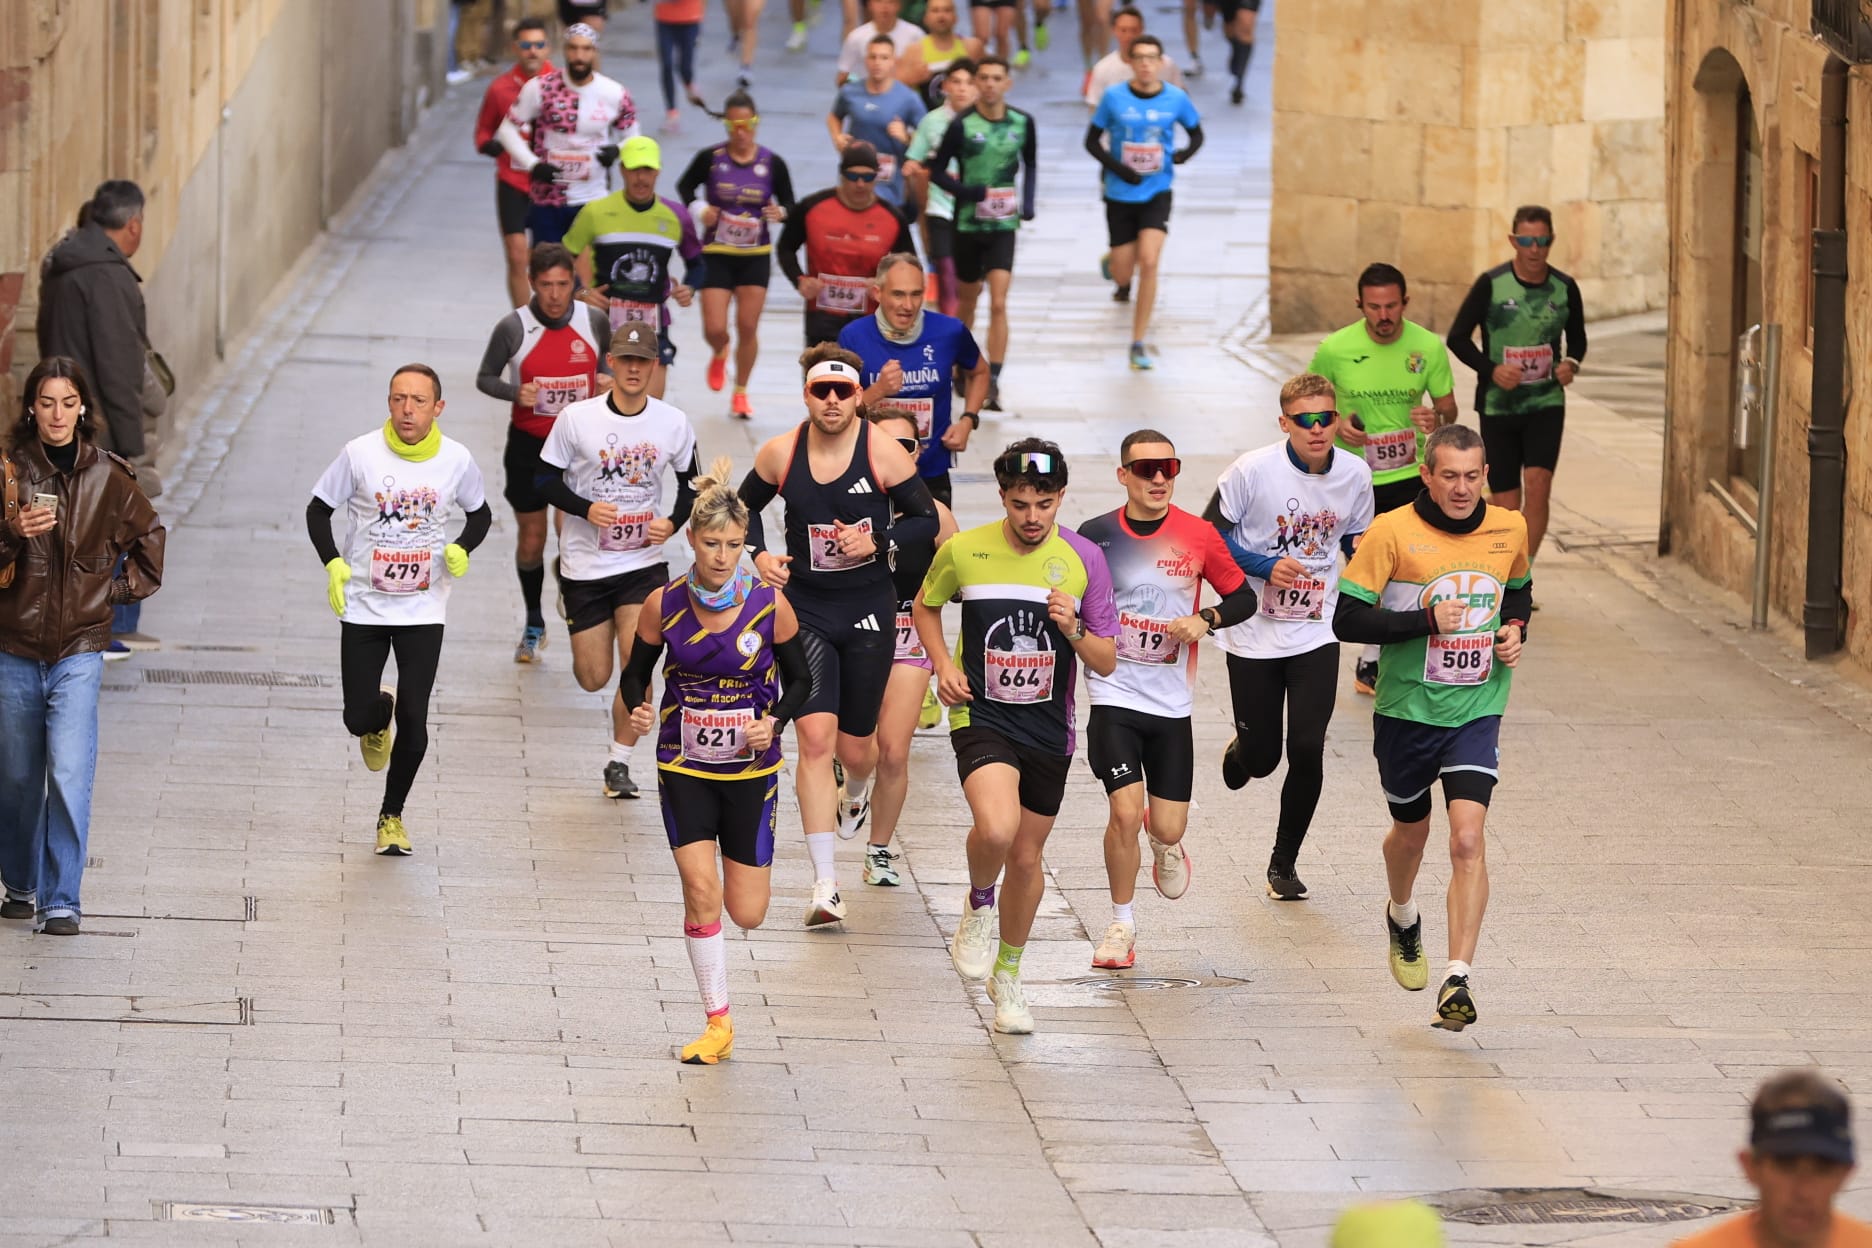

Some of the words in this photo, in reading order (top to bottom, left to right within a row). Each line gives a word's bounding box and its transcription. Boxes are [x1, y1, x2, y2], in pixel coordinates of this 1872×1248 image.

[828, 286, 856, 300] 566
[546, 388, 577, 404] 375
[1376, 443, 1408, 460] 583
[611, 524, 643, 540] 391
[373, 550, 431, 563] bedunia
[384, 563, 420, 580] 479
[1166, 566, 1194, 577] club
[1277, 589, 1311, 608] 194
[1138, 631, 1164, 651] 19
[1429, 635, 1492, 651] bedunia
[986, 652, 1054, 668] bedunia
[1442, 650, 1482, 669] 508
[999, 668, 1040, 687] 664
[696, 727, 737, 748] 621
